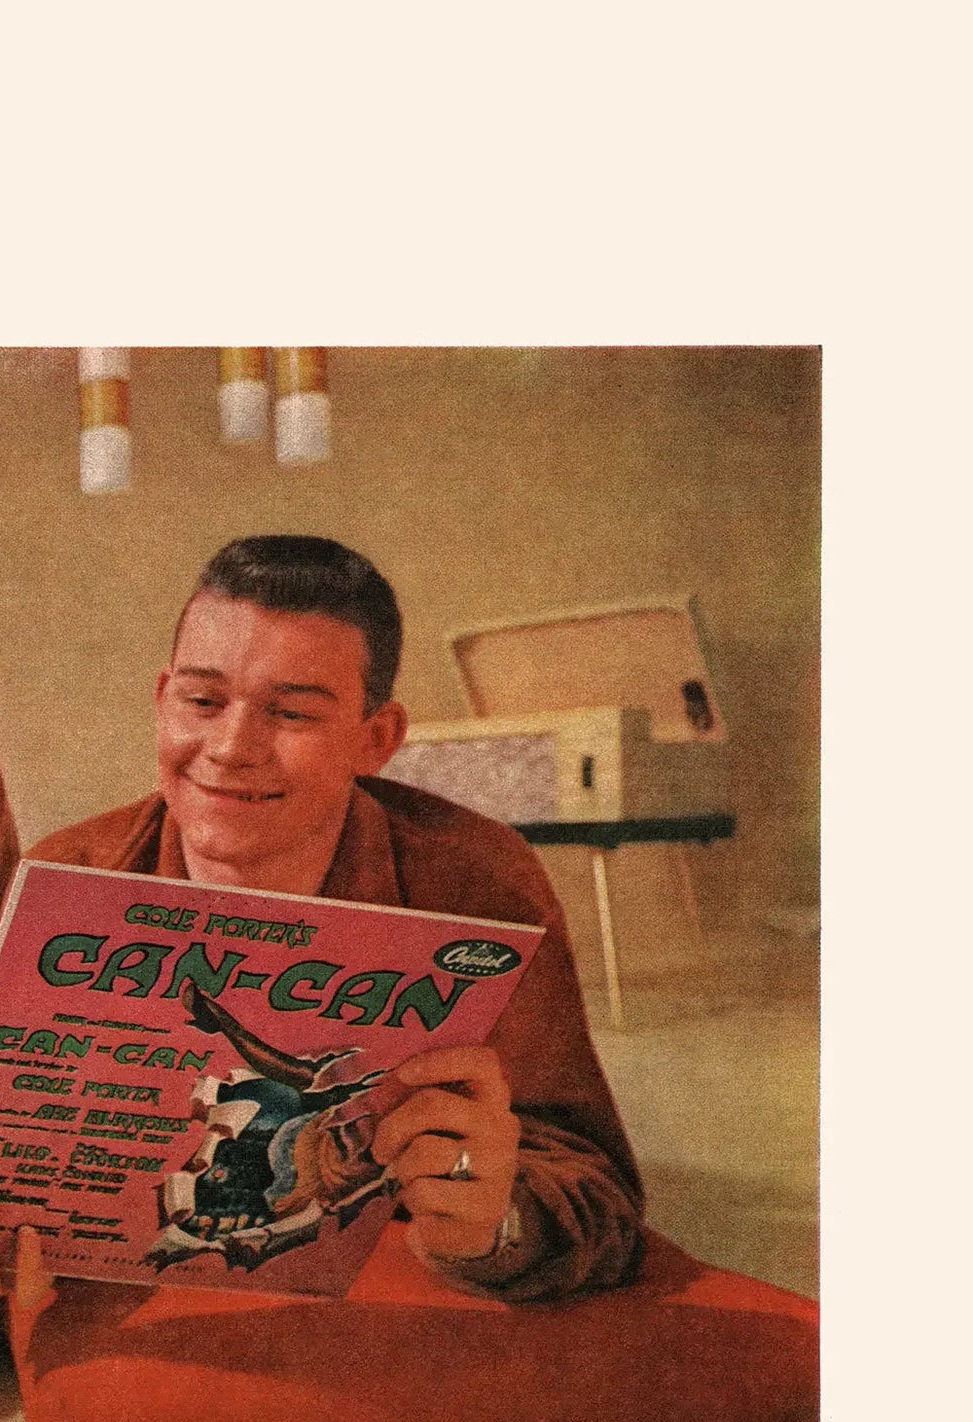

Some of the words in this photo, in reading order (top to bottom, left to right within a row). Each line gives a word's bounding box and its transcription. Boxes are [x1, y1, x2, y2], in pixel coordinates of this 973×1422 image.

[125, 904, 200, 932] COLE
[37, 933, 479, 1031] CAN-CAN
[12, 1074, 76, 1096] COLE
[81, 1080, 163, 1107] PORTER
